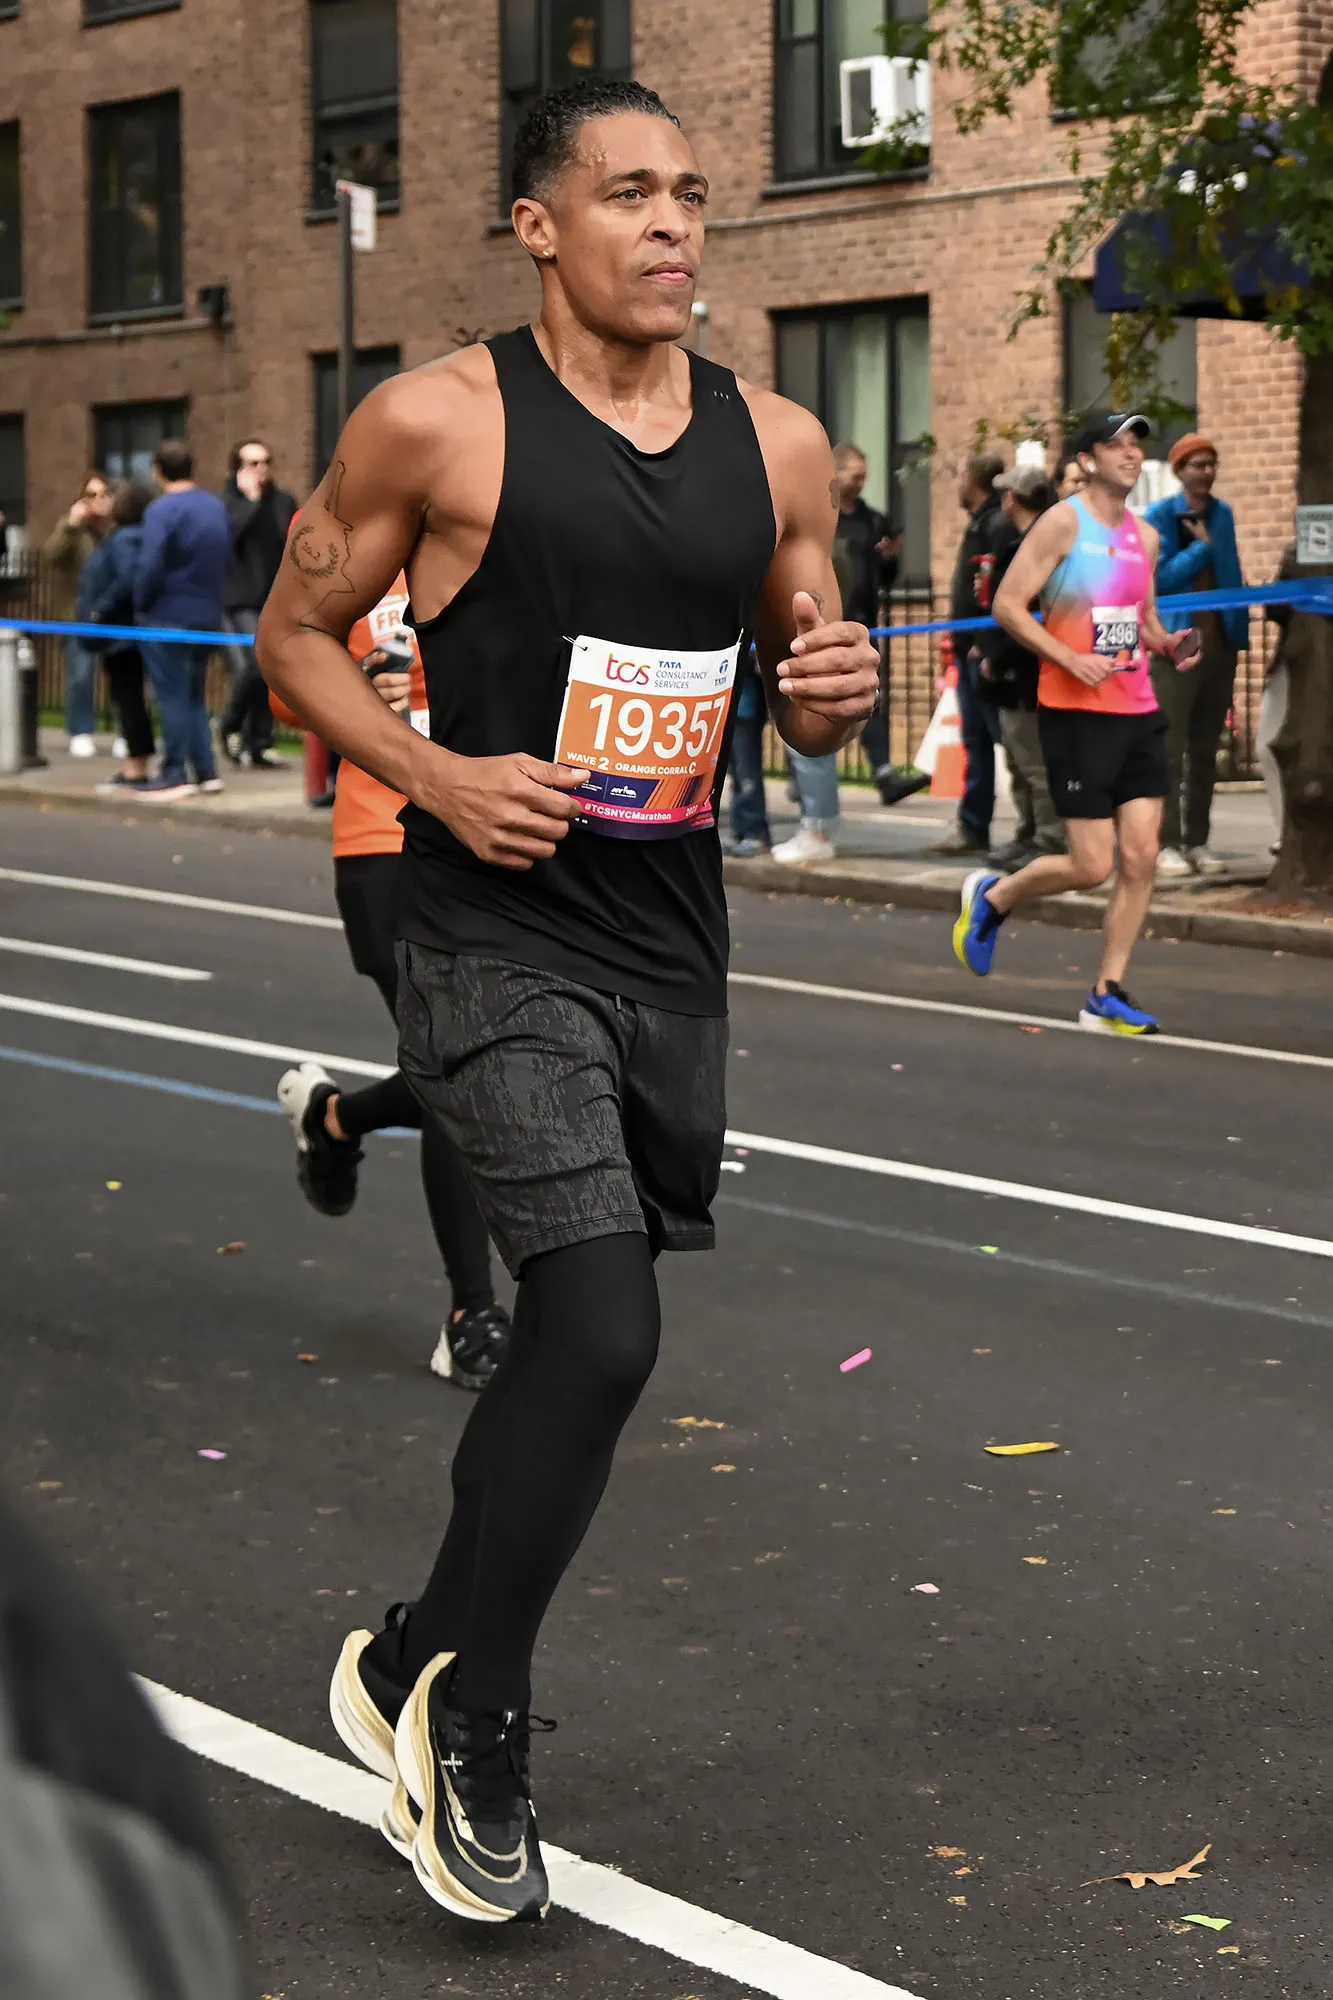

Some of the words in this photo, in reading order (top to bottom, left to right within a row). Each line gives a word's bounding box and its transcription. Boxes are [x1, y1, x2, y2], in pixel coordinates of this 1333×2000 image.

[606, 653, 651, 686] tcs
[658, 661, 682, 669] TATA
[655, 670, 708, 680] CONSULTANCY
[654, 680, 689, 689] SERVICES
[589, 693, 726, 759] 19357
[567, 751, 597, 766] WAVE
[598, 757, 610, 771] 2
[615, 762, 656, 775] ORANGE
[657, 766, 688, 775] CORRAL
[688, 761, 697, 775] C
[585, 802, 672, 820] #TCSNYCMarathon
